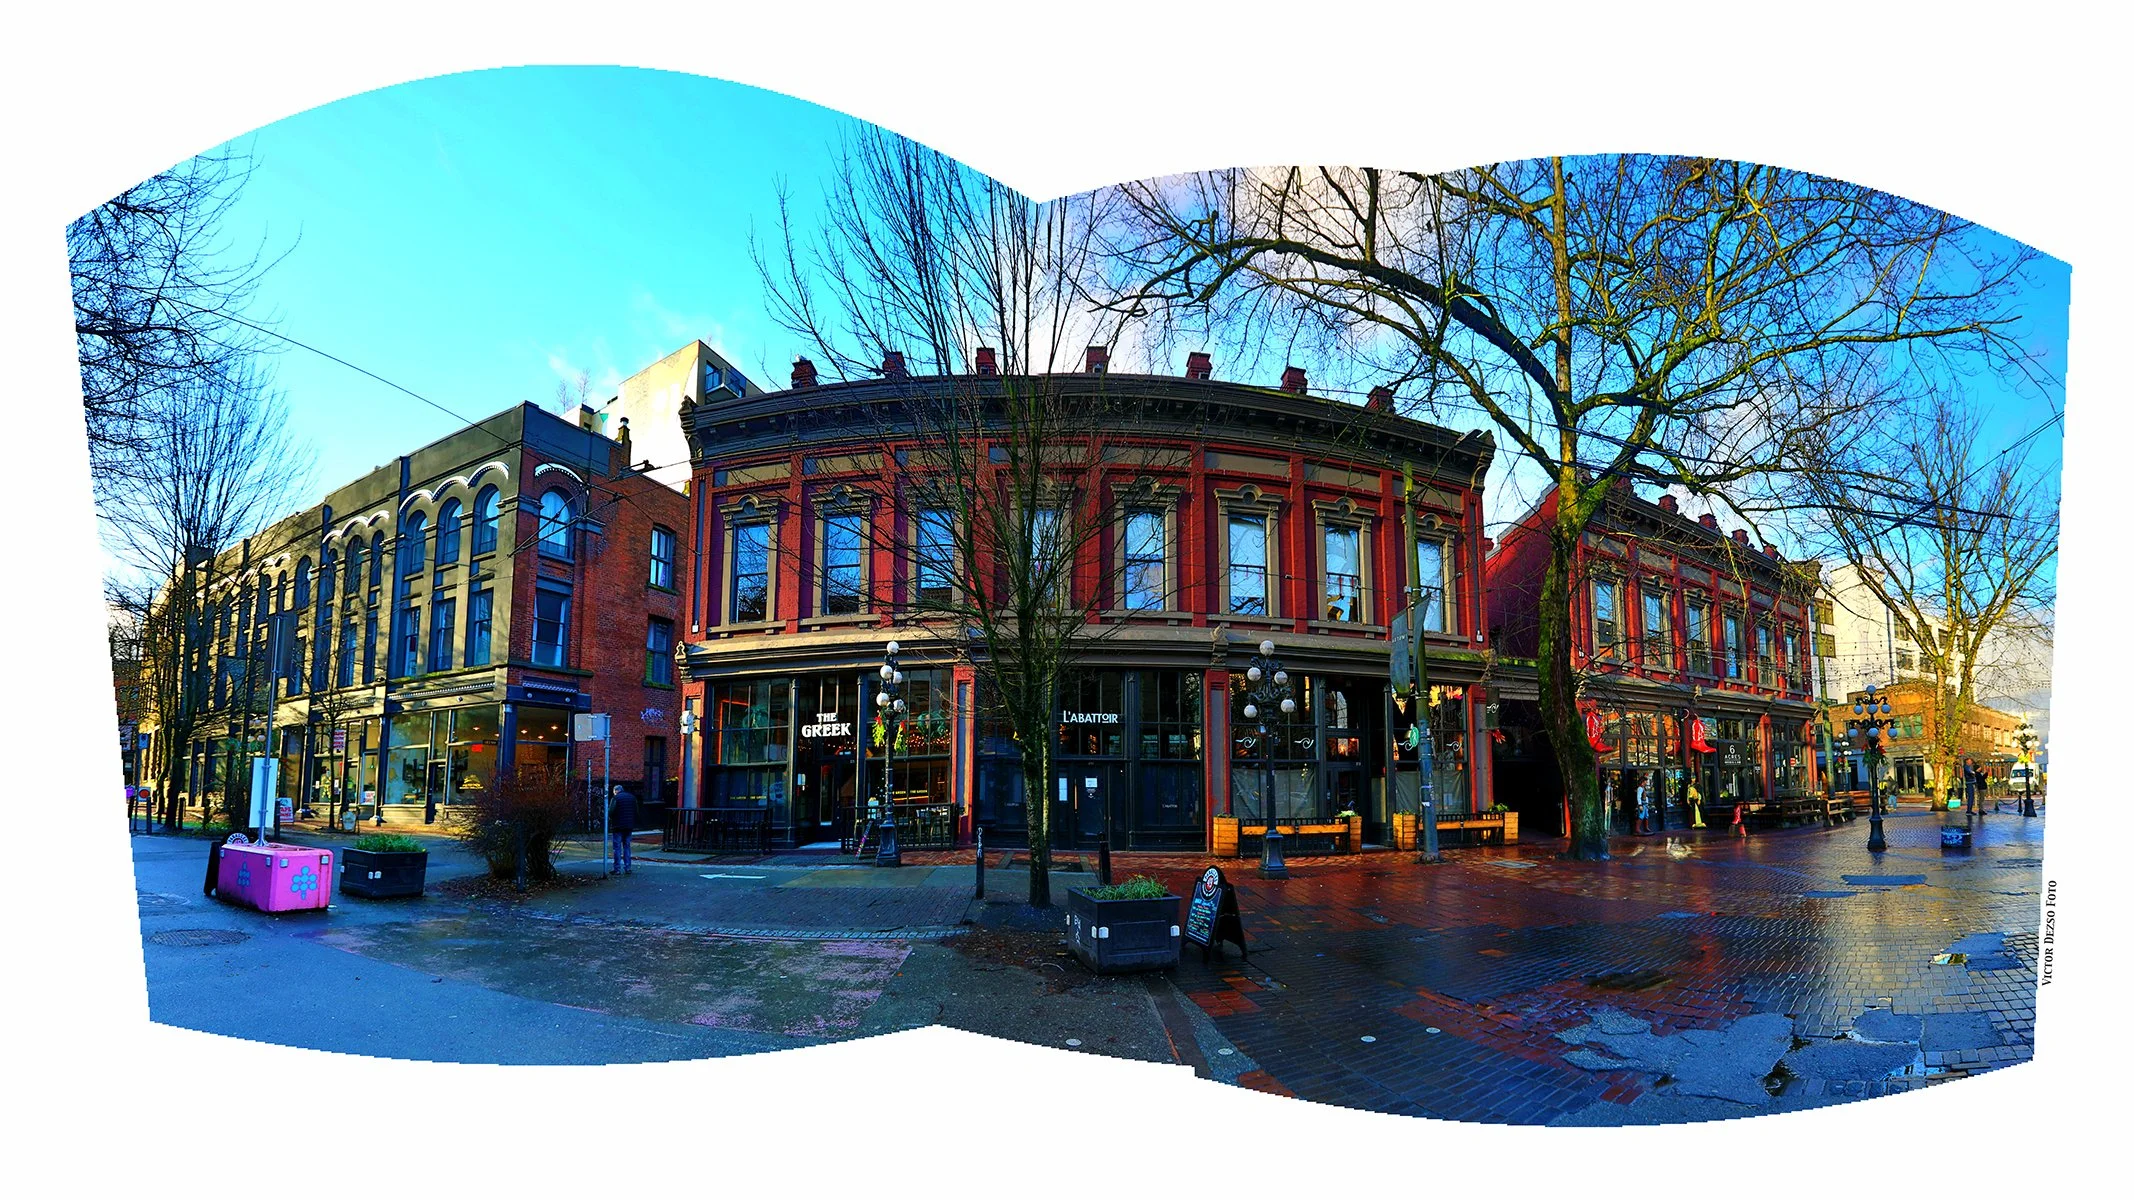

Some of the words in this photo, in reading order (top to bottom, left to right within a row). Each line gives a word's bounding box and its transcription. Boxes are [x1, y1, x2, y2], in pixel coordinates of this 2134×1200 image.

[816, 712, 838, 723] THE
[1063, 710, 1118, 724] L'ABATTOIR
[801, 722, 851, 738] GREEK
[1729, 744, 1736, 755] 6
